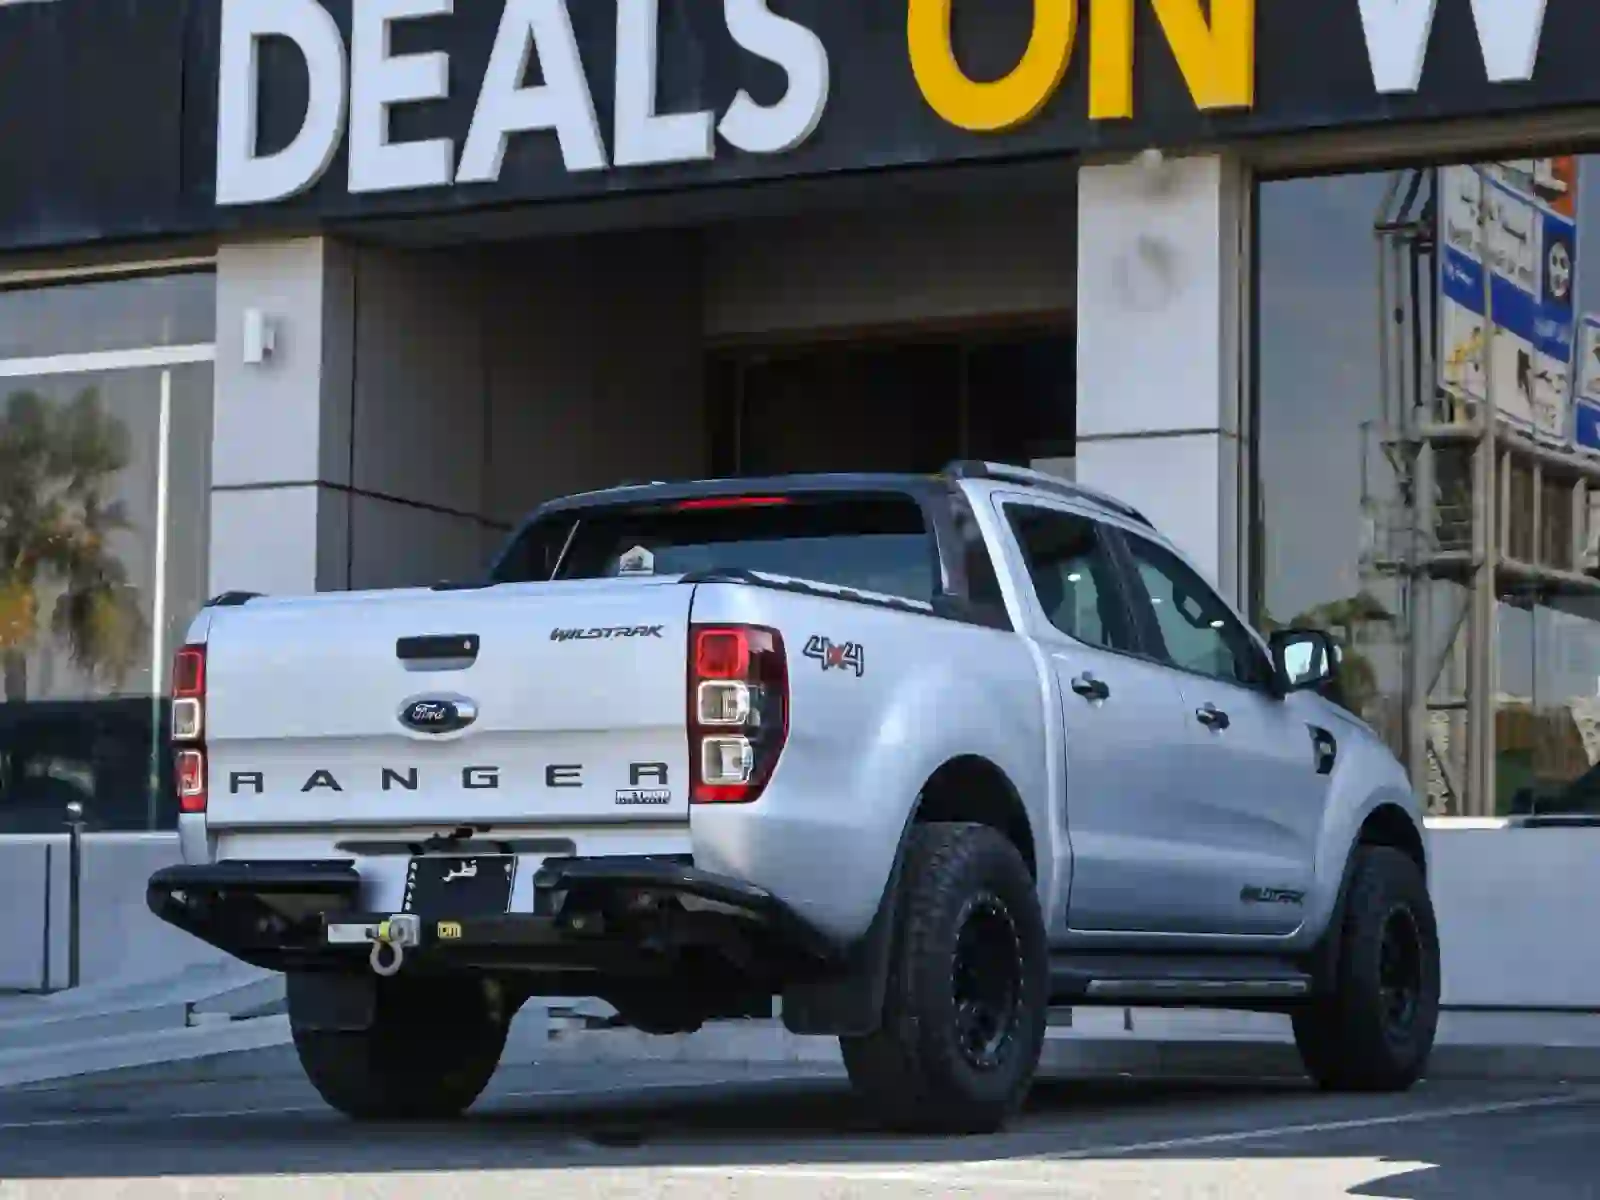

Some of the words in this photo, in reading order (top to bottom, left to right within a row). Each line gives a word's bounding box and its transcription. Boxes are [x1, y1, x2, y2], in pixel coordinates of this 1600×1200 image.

[216, 0, 829, 205] DEALS
[907, 0, 1254, 131] ON
[412, 703, 446, 720] Ford
[229, 762, 669, 794] RANGER
